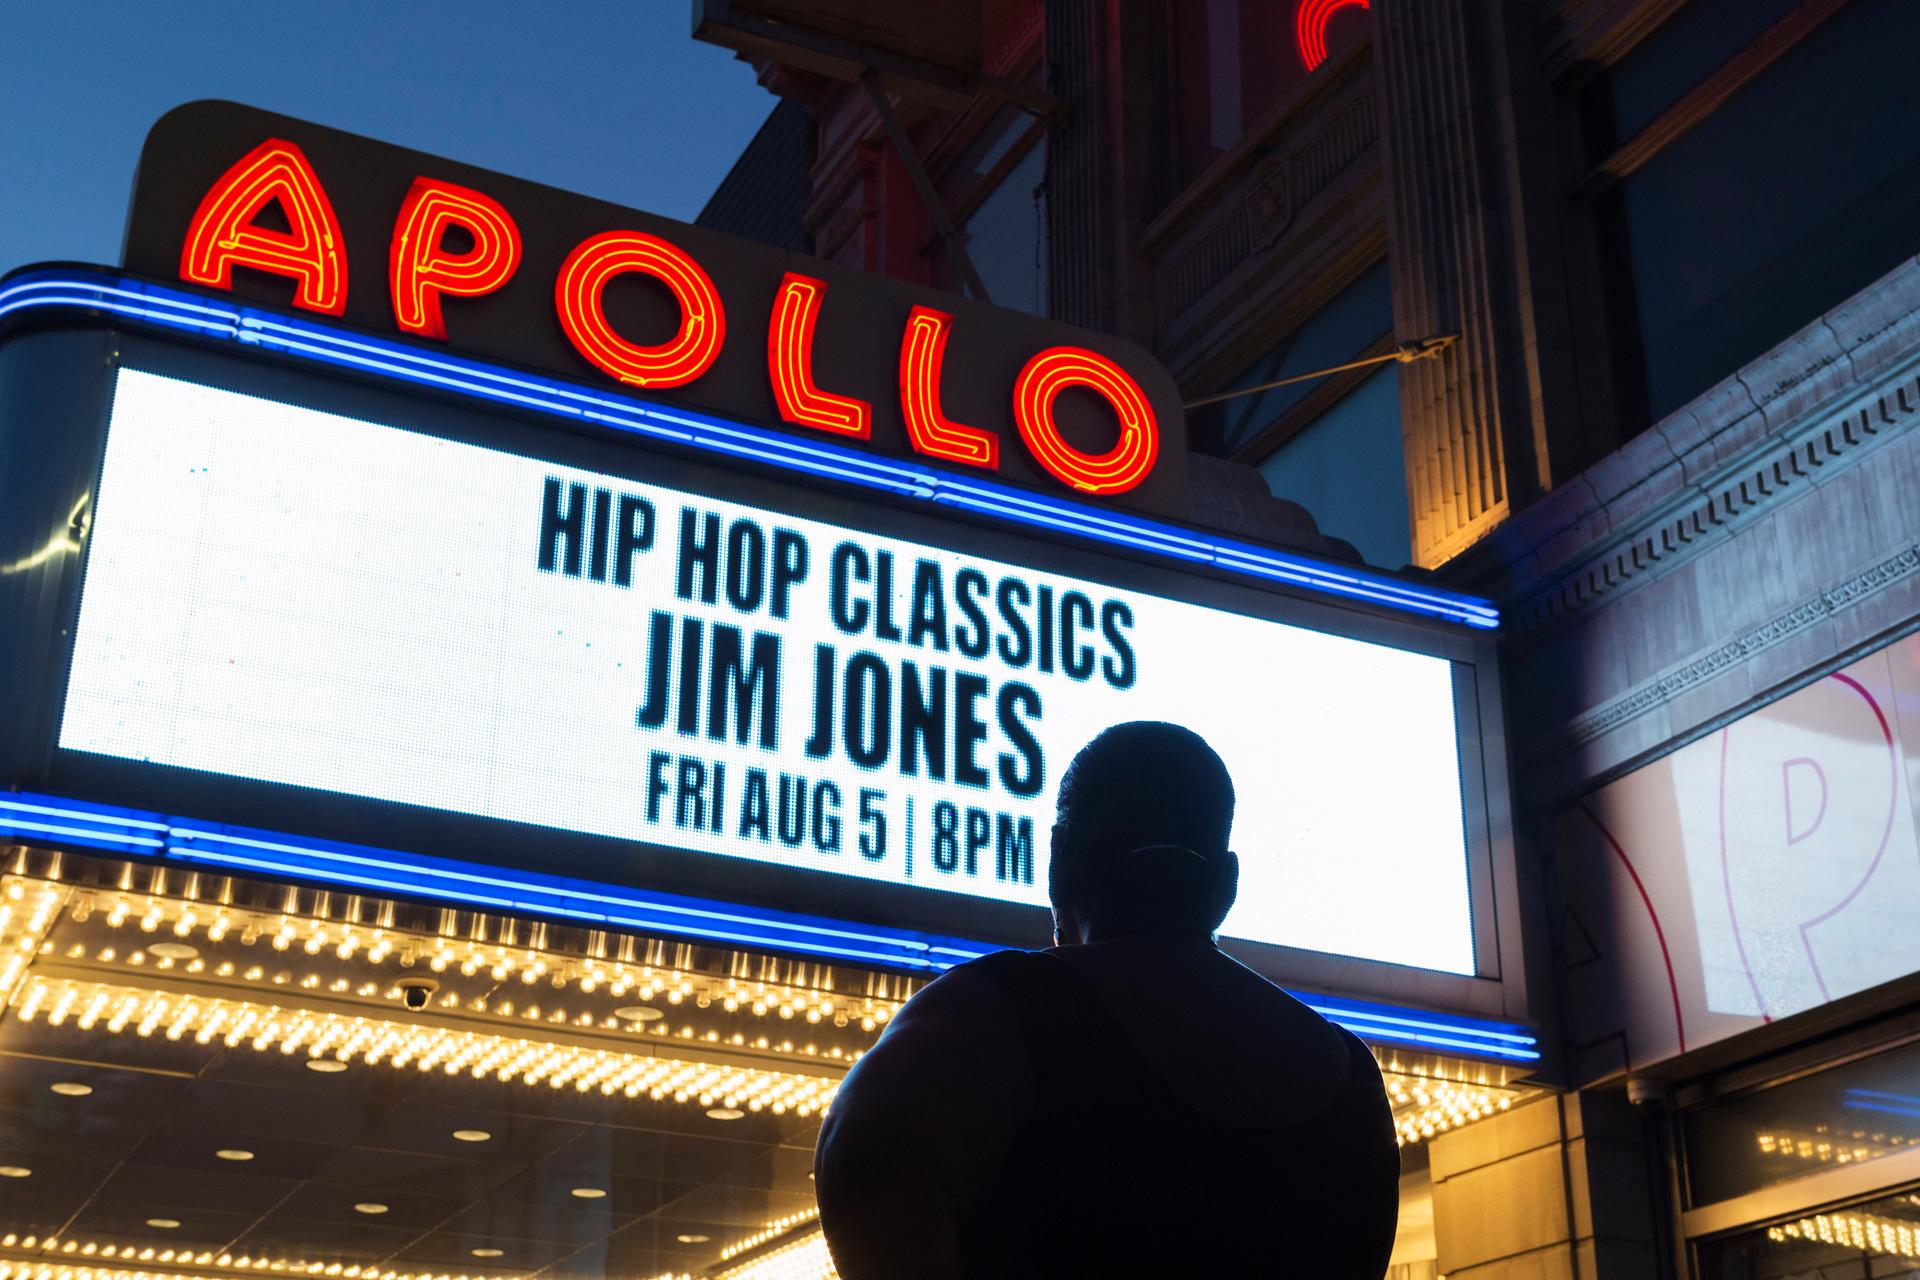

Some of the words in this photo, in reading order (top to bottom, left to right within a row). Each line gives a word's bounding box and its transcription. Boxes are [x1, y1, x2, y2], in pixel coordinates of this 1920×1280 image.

[181, 138, 1160, 496] APOLLO
[539, 476, 656, 588] HIP
[675, 504, 810, 620] HOP
[830, 541, 1136, 690] CLASSICS
[636, 609, 784, 751] JIM
[804, 643, 1046, 799] JONES
[645, 751, 725, 832] FRI
[739, 767, 844, 853] AUG
[858, 789, 888, 862] 5
[932, 801, 1034, 886] 8PM
